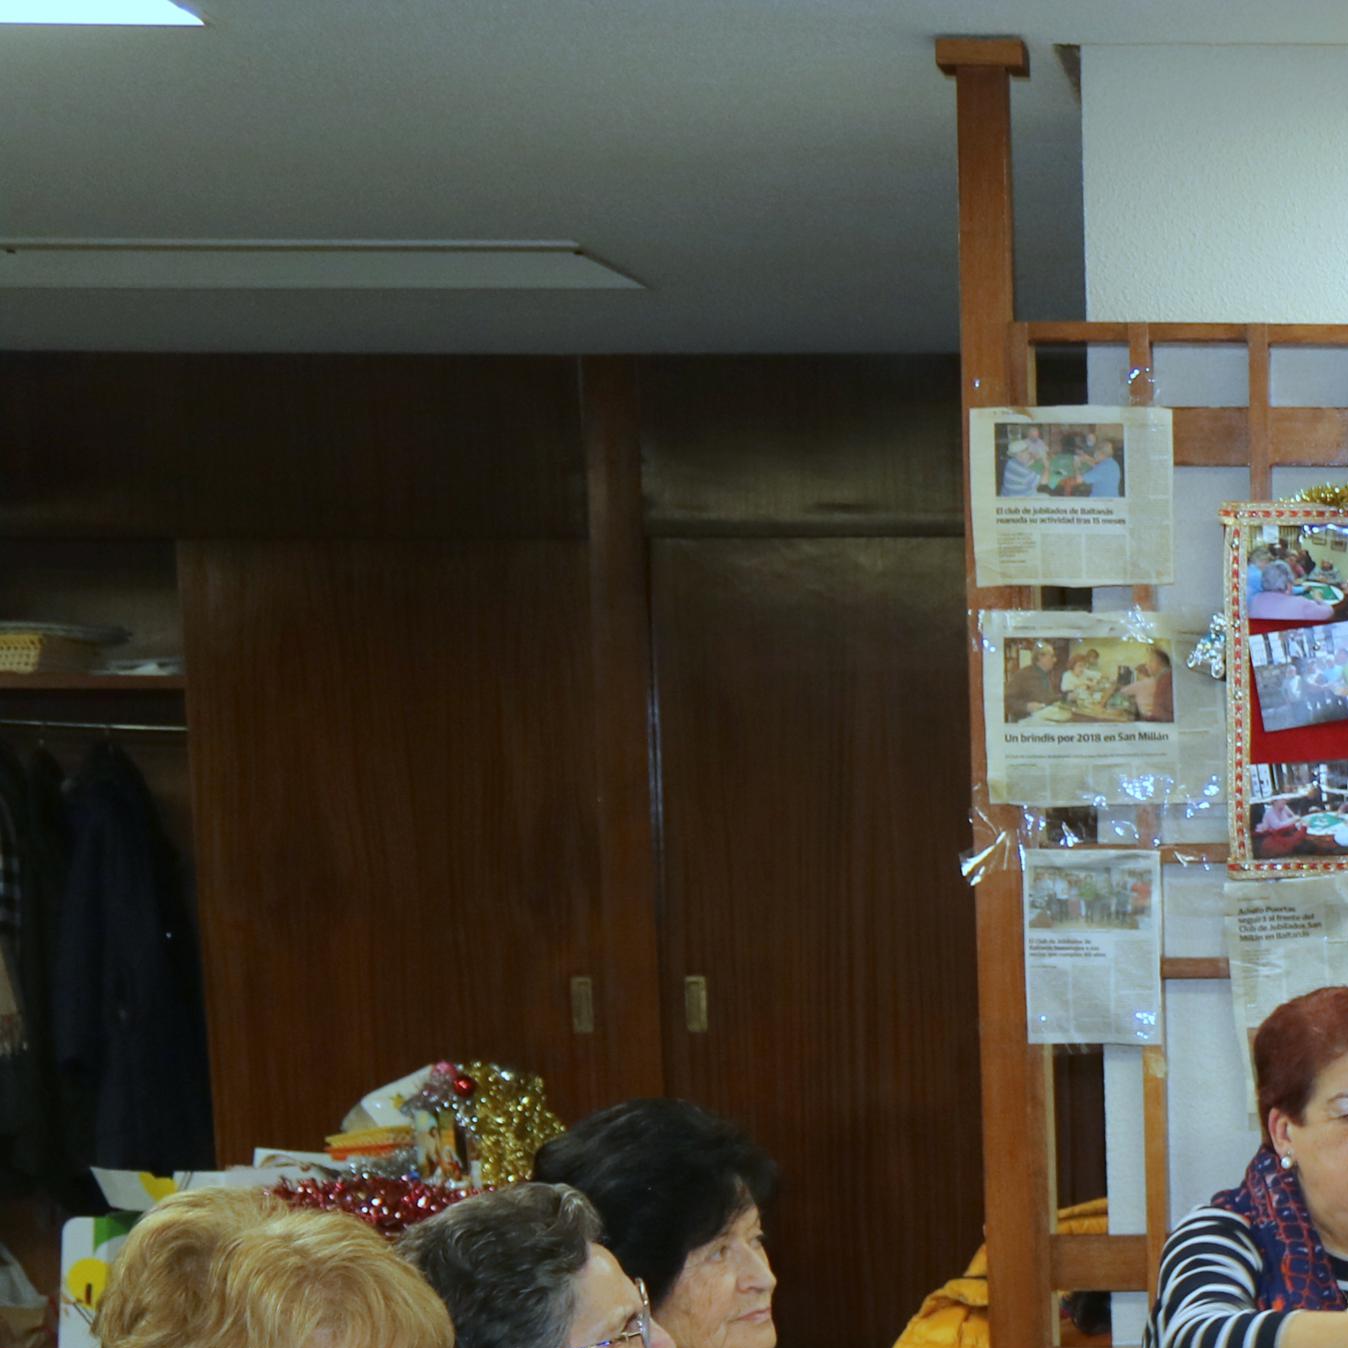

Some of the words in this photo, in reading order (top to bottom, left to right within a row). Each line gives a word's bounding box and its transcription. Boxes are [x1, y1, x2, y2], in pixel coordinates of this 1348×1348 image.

[1022, 506, 1031, 515] de
[1069, 506, 1079, 515] de
[1004, 733, 1018, 743] Un
[1020, 731, 1055, 743] brindis
[1057, 735, 1074, 745] por
[1076, 733, 1101, 743] 2018
[1103, 735, 1116, 743] en
[1118, 731, 1137, 742] San
[1138, 729, 1169, 742] Millán
